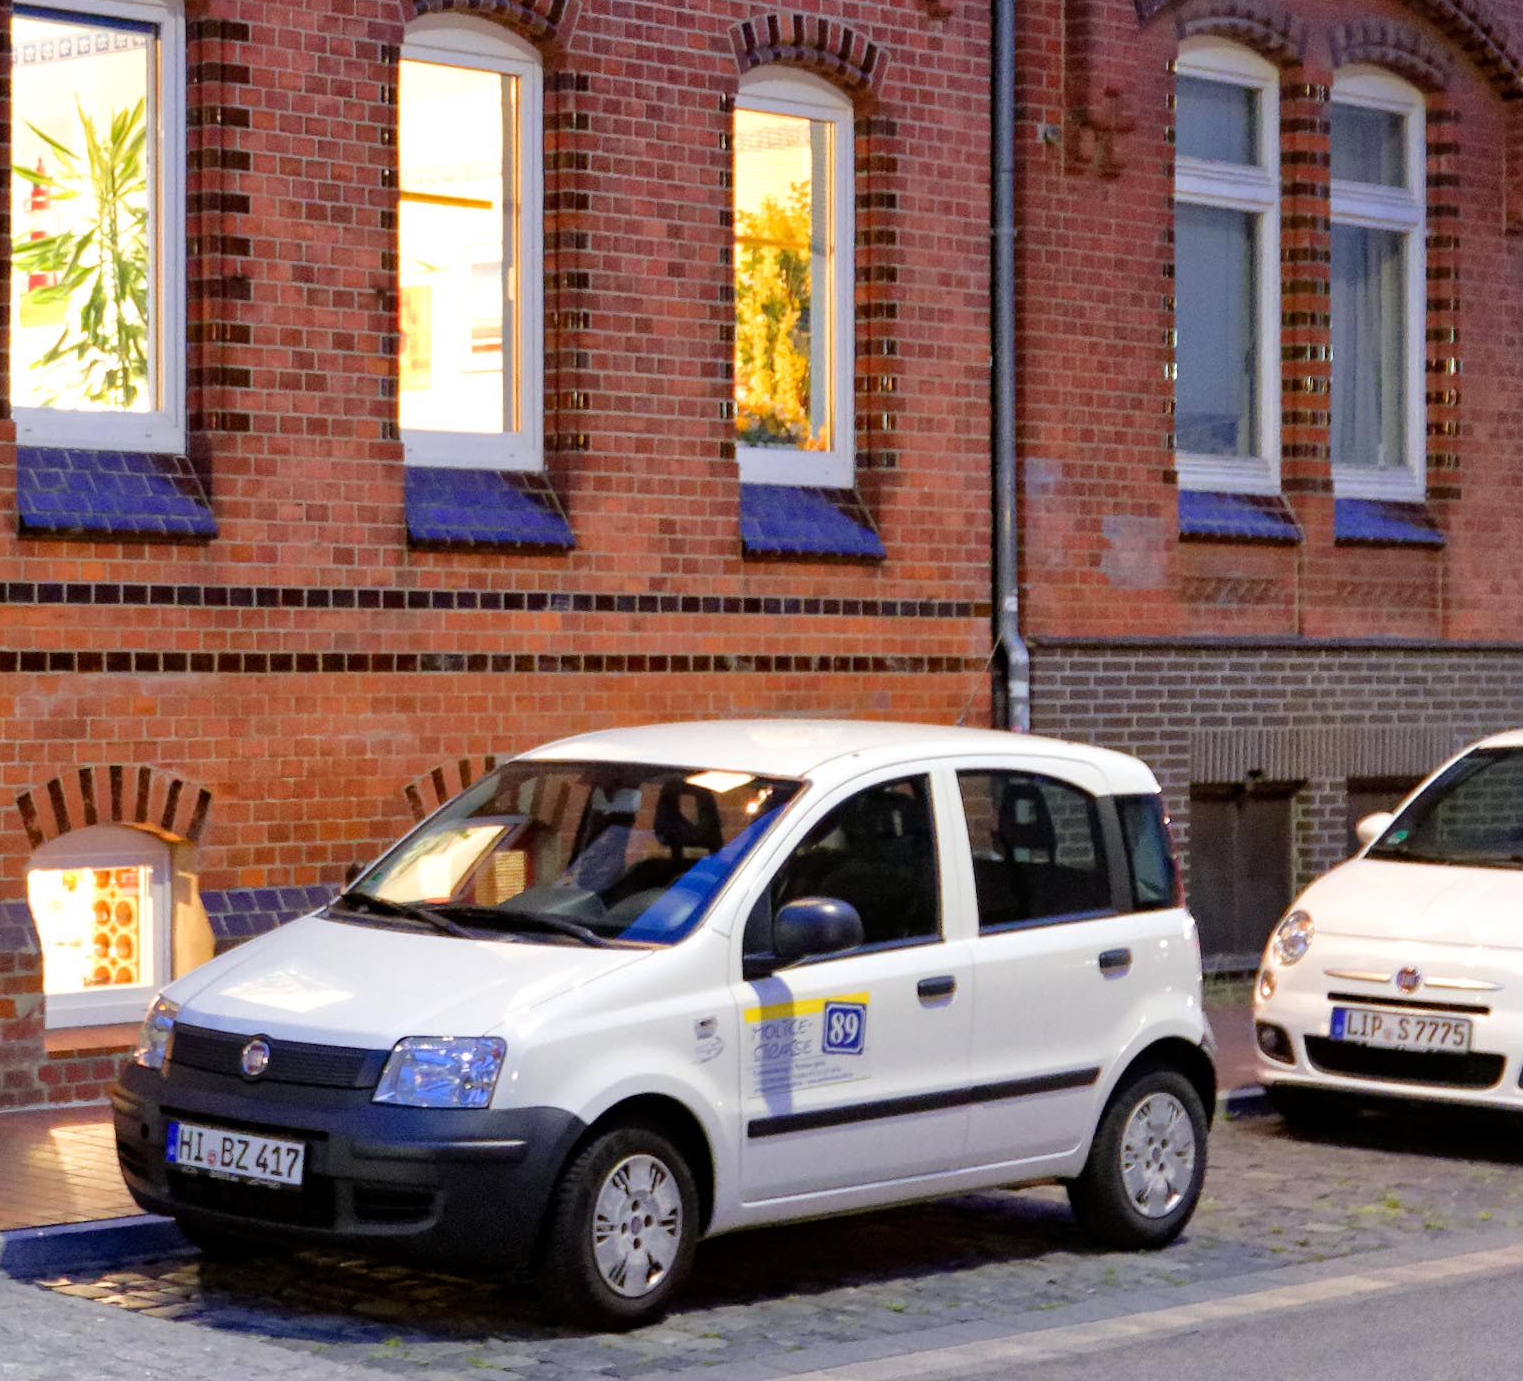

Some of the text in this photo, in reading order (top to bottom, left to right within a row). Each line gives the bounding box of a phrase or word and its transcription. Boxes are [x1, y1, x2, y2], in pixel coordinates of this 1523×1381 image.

[829, 1011, 860, 1045] 89
[1347, 1012, 1383, 1037] LIP
[179, 1128, 204, 1162] HI
[220, 1136, 250, 1171] BZ
[255, 1143, 301, 1178] 417
